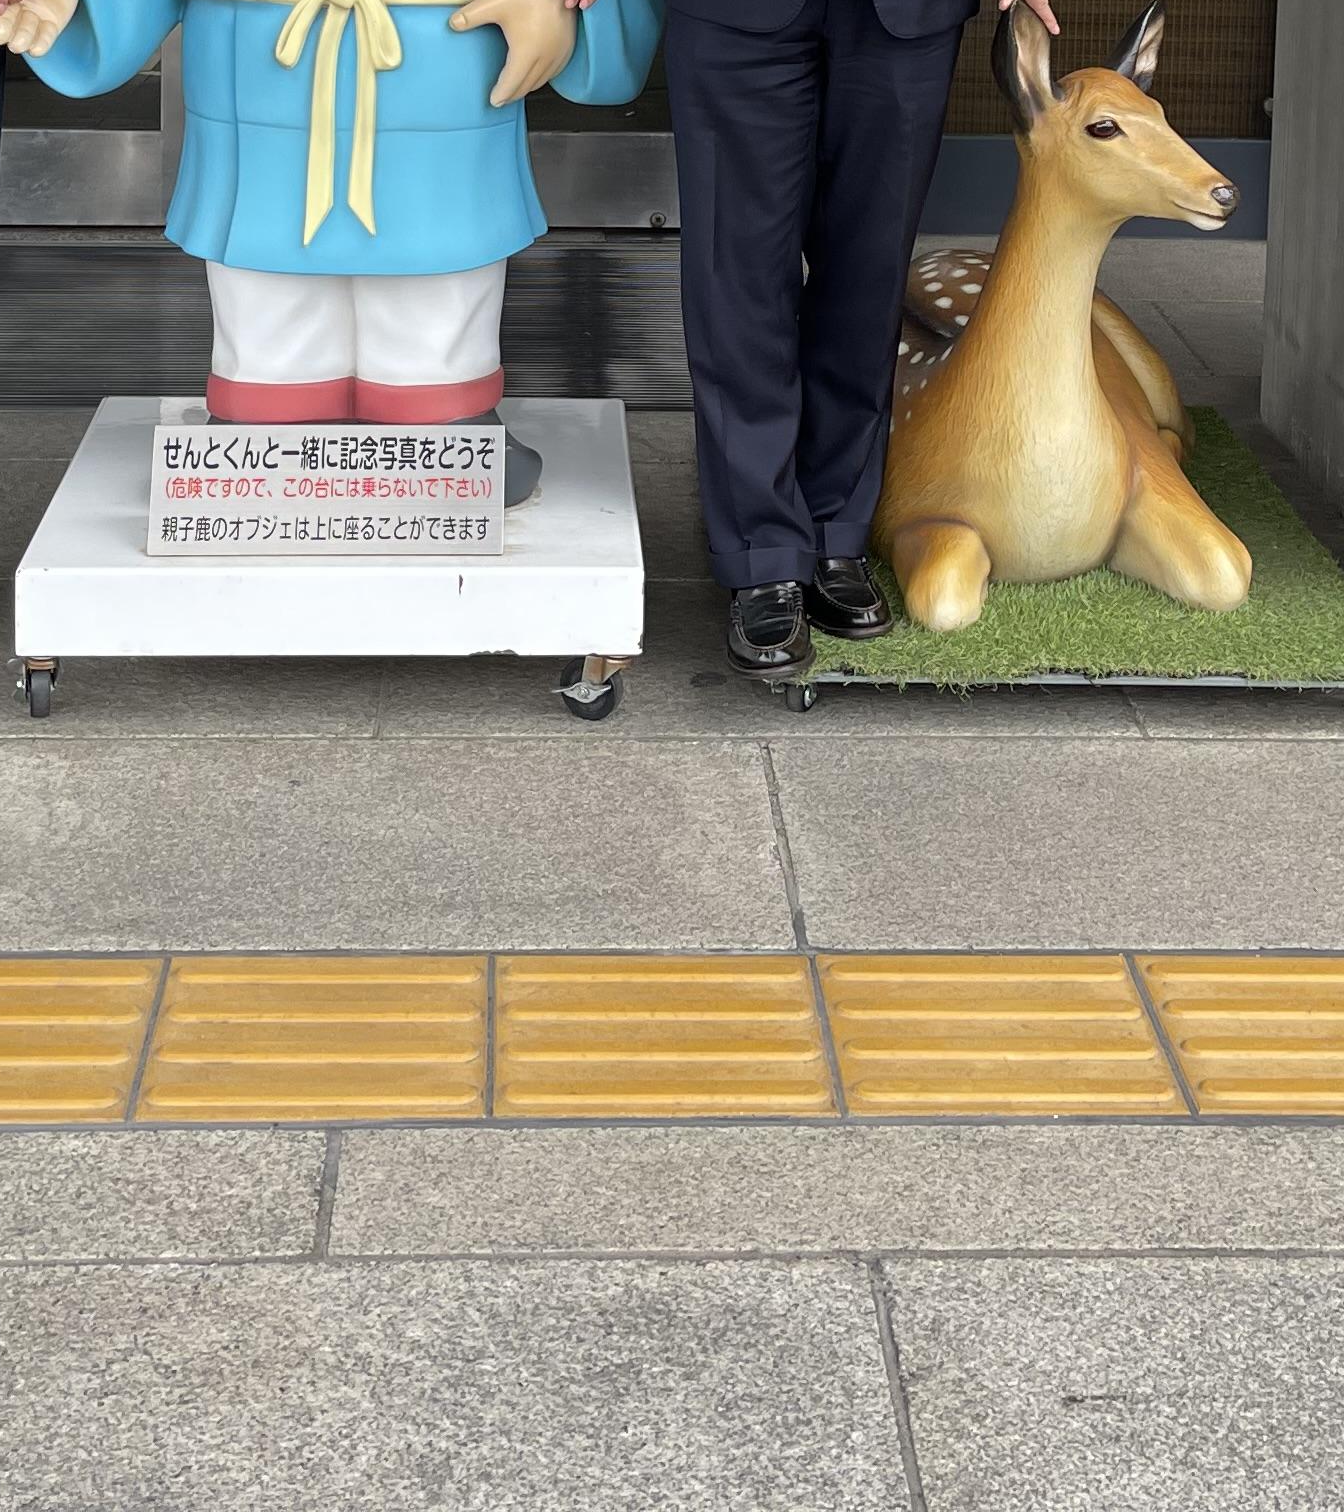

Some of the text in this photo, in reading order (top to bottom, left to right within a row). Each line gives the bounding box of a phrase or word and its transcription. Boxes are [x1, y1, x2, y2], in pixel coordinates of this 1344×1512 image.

[163, 436, 495, 470] せんとくんと一緒に記念写真をどうぞ
[161, 515, 490, 541] 親子鹿のオブジェは上に座ることができます
